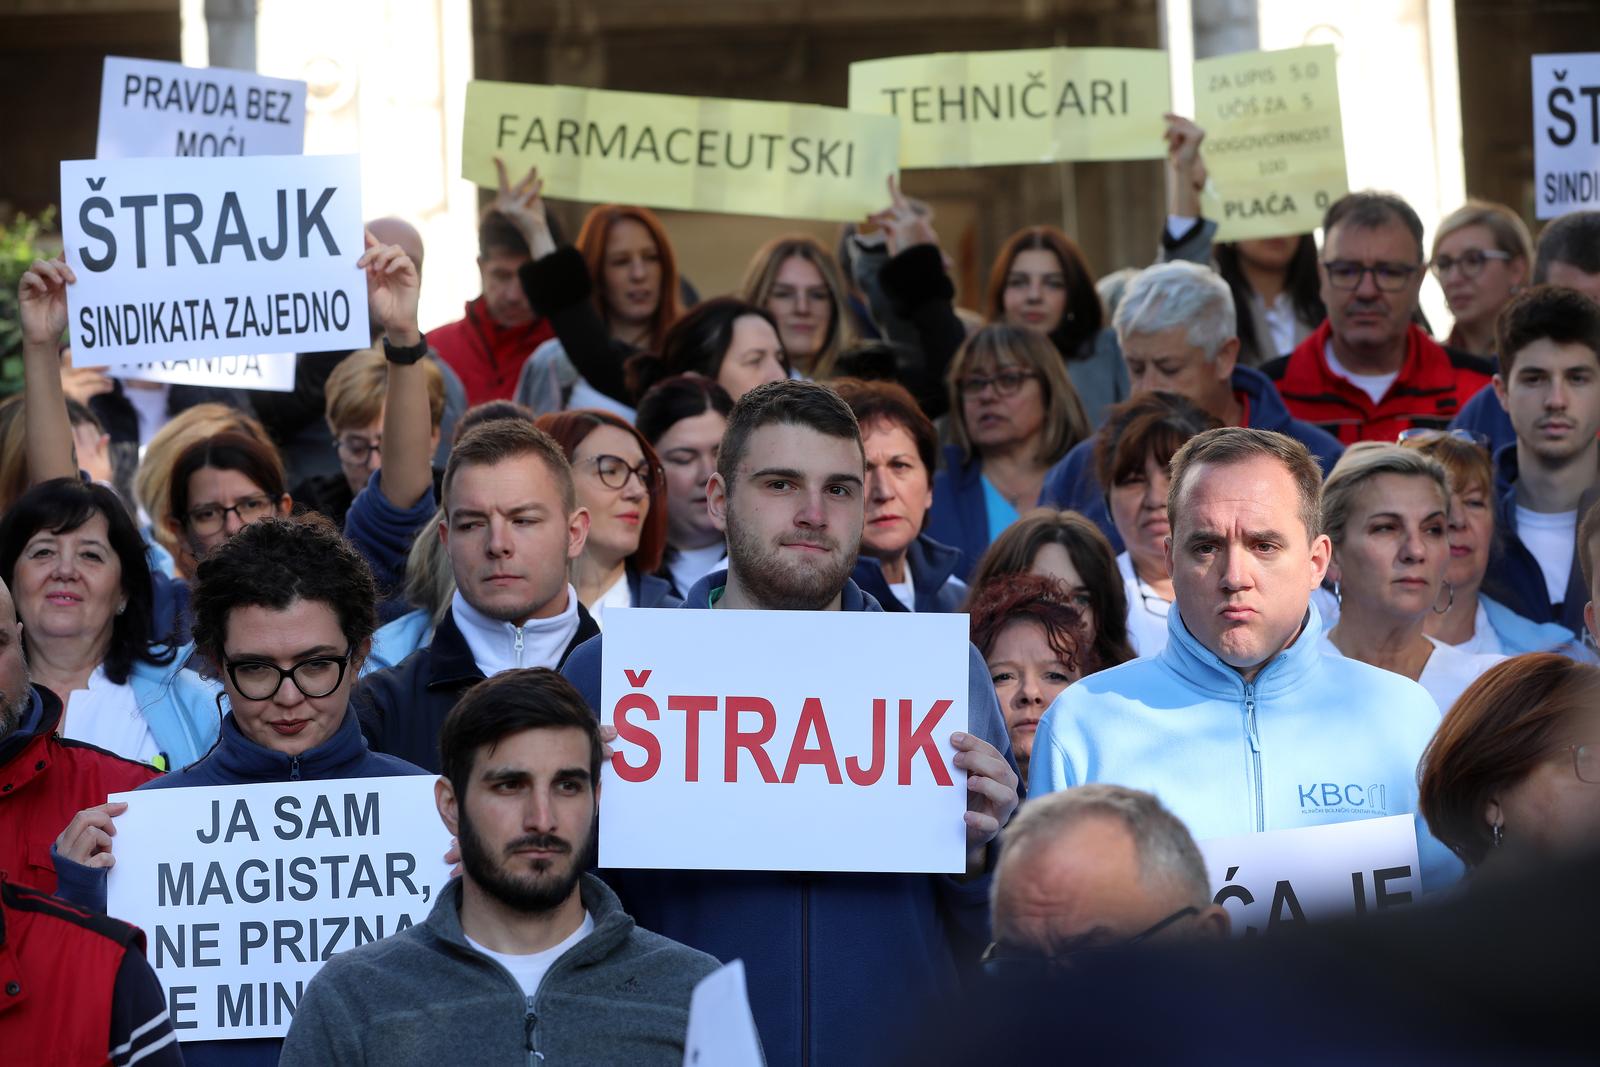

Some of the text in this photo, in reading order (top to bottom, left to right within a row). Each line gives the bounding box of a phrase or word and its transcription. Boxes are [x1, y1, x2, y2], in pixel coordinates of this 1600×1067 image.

[124, 75, 292, 124] PRAVDA BEZ
[882, 71, 1128, 124] TEHNIČARI
[496, 114, 854, 177] FARMACEUTSKI
[78, 177, 341, 273] ŠTRAJK
[1225, 190, 1296, 219] PLAĆA
[80, 289, 350, 348] SINDIKATA ZAJEDNO
[611, 669, 955, 786] ŠTRAJK
[196, 792, 380, 844] JA SAM
[157, 852, 431, 907] MAGISTAR,
[155, 923, 221, 969] NE
